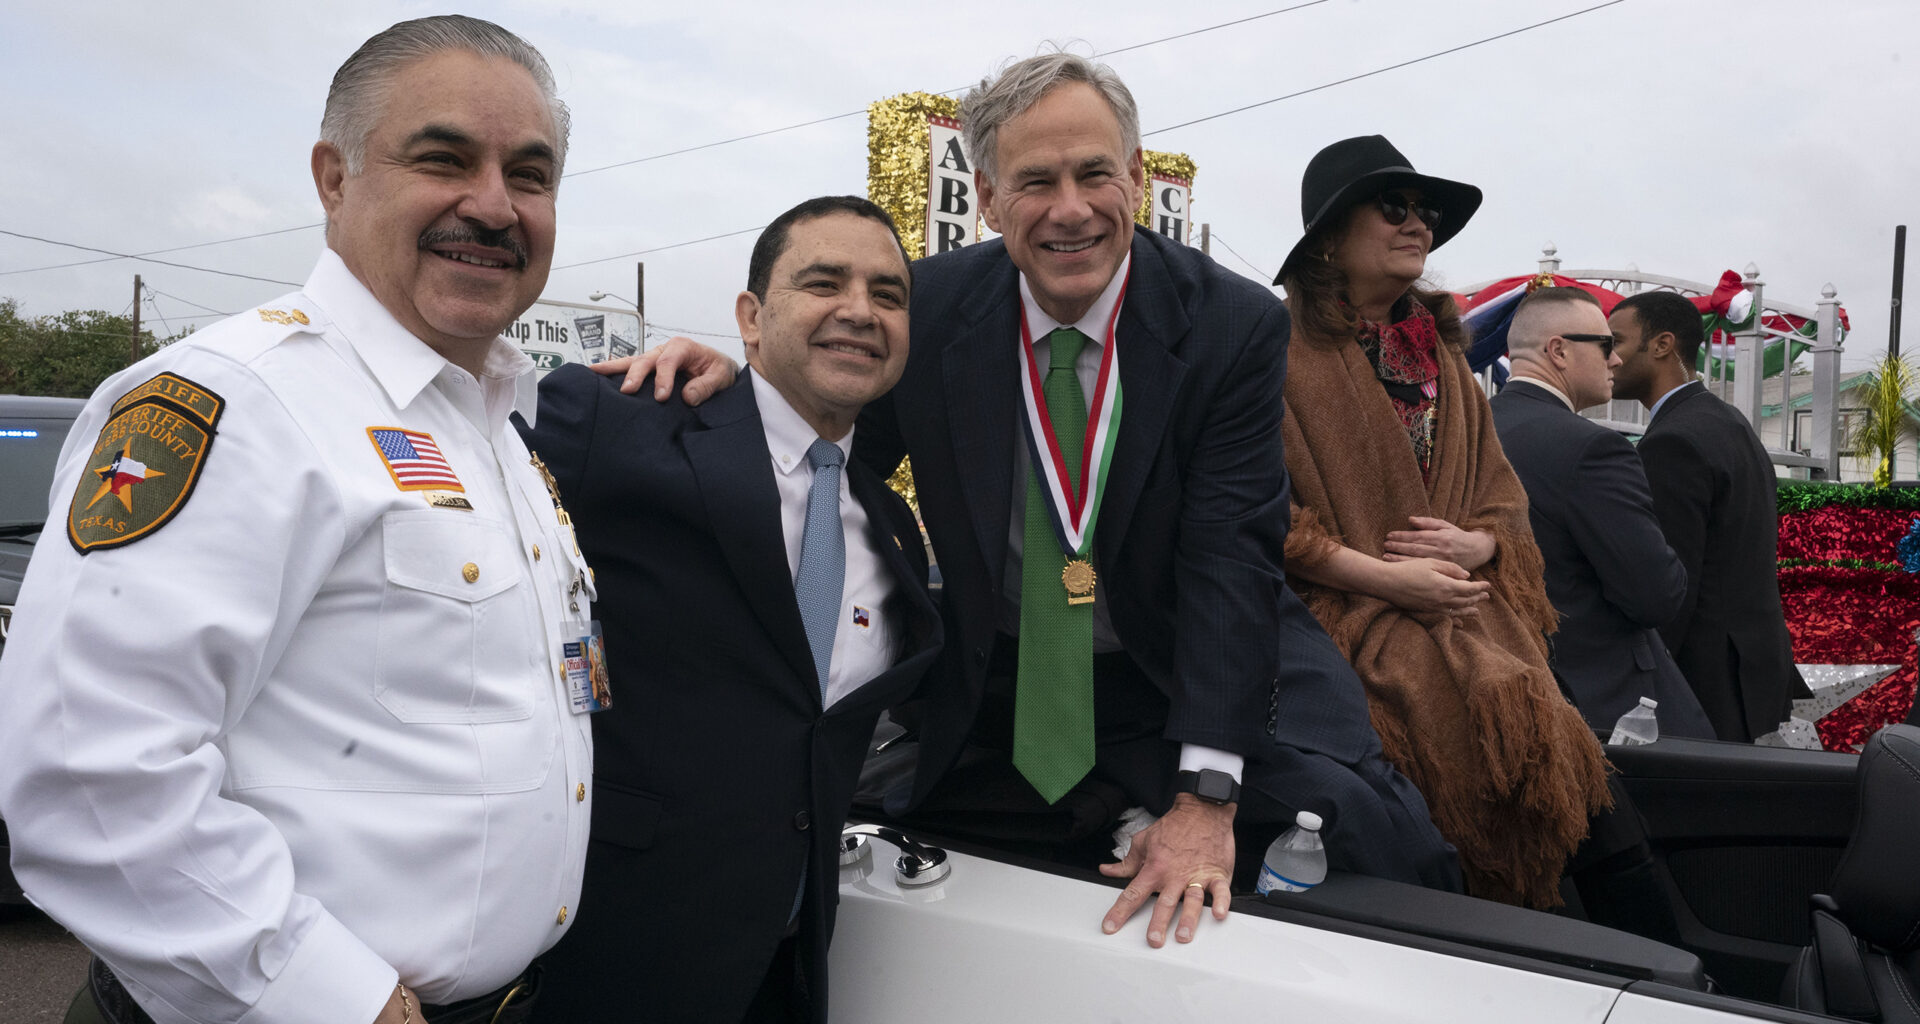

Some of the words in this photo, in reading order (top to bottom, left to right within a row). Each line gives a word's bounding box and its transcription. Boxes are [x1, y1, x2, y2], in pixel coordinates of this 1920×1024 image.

[502, 317, 530, 344] kip
[535, 319, 568, 343] This
[112, 407, 186, 432] SHERIFF
[129, 420, 197, 460] COUNTY
[79, 515, 126, 533] TEXAS
